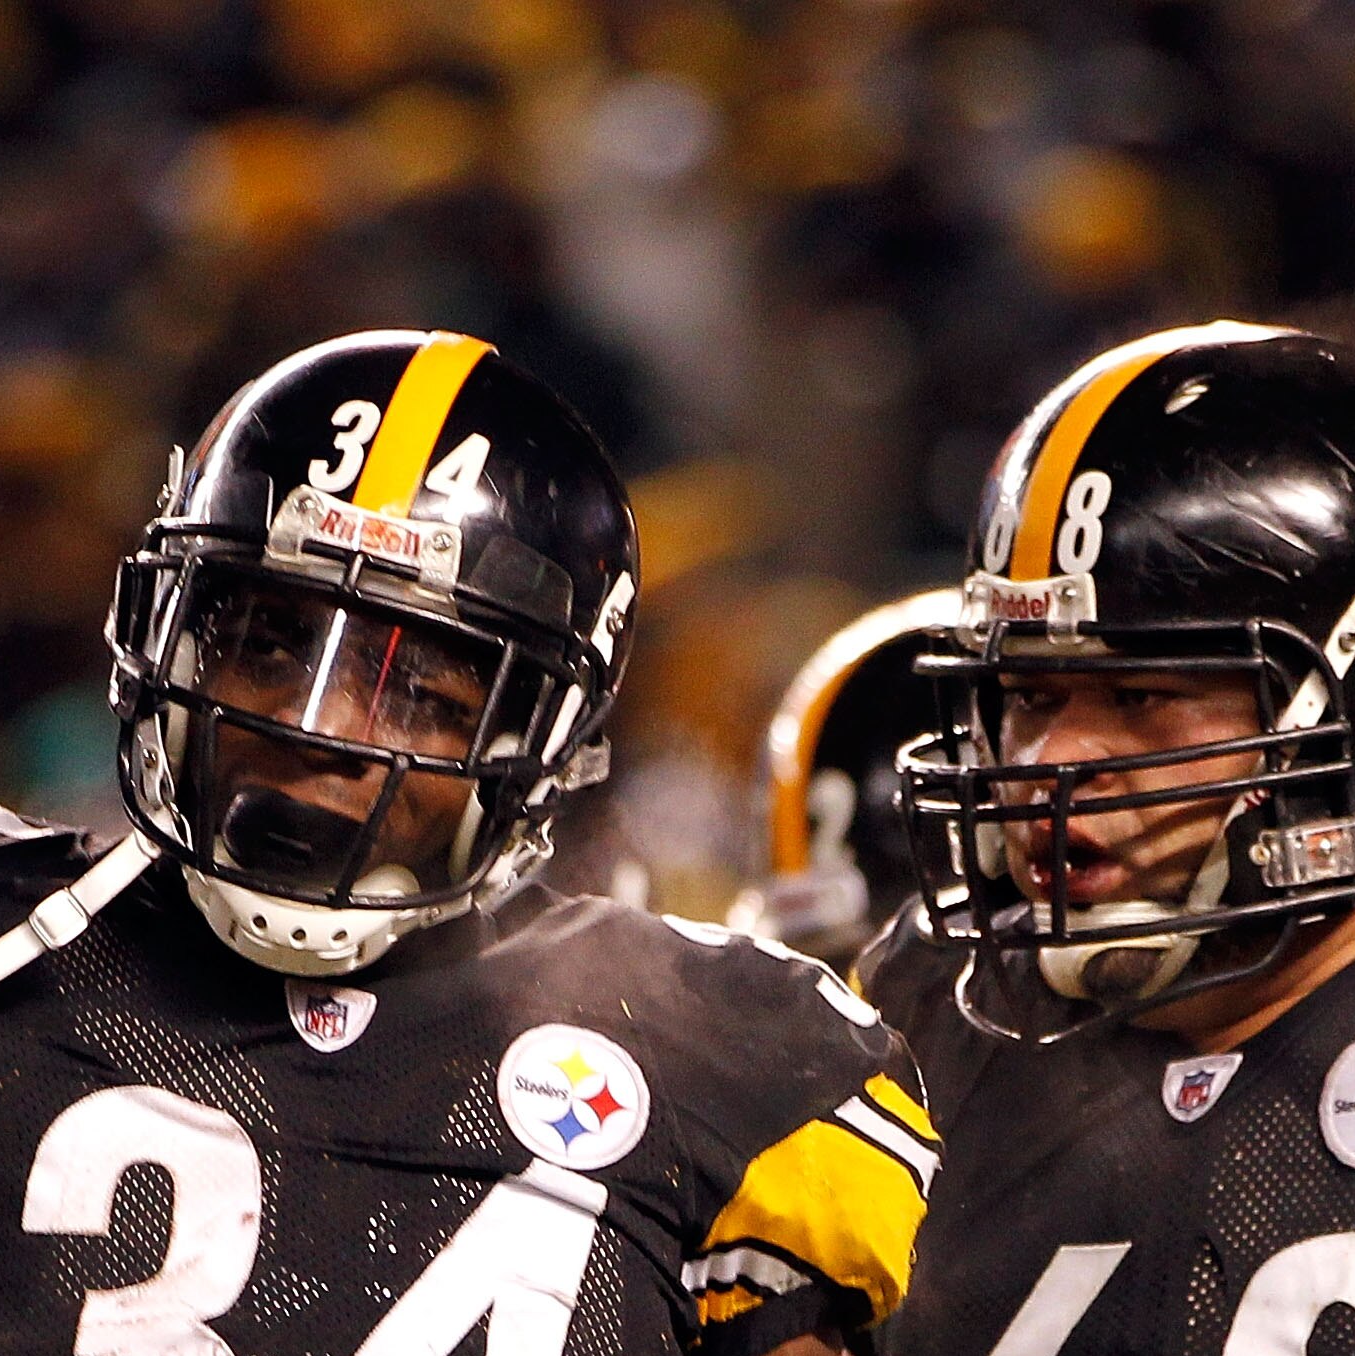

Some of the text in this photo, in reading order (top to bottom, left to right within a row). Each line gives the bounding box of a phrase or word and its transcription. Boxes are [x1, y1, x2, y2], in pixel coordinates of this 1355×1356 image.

[308, 400, 491, 525] 34
[307, 1009, 345, 1038] NFL
[514, 1074, 569, 1101] Steelers
